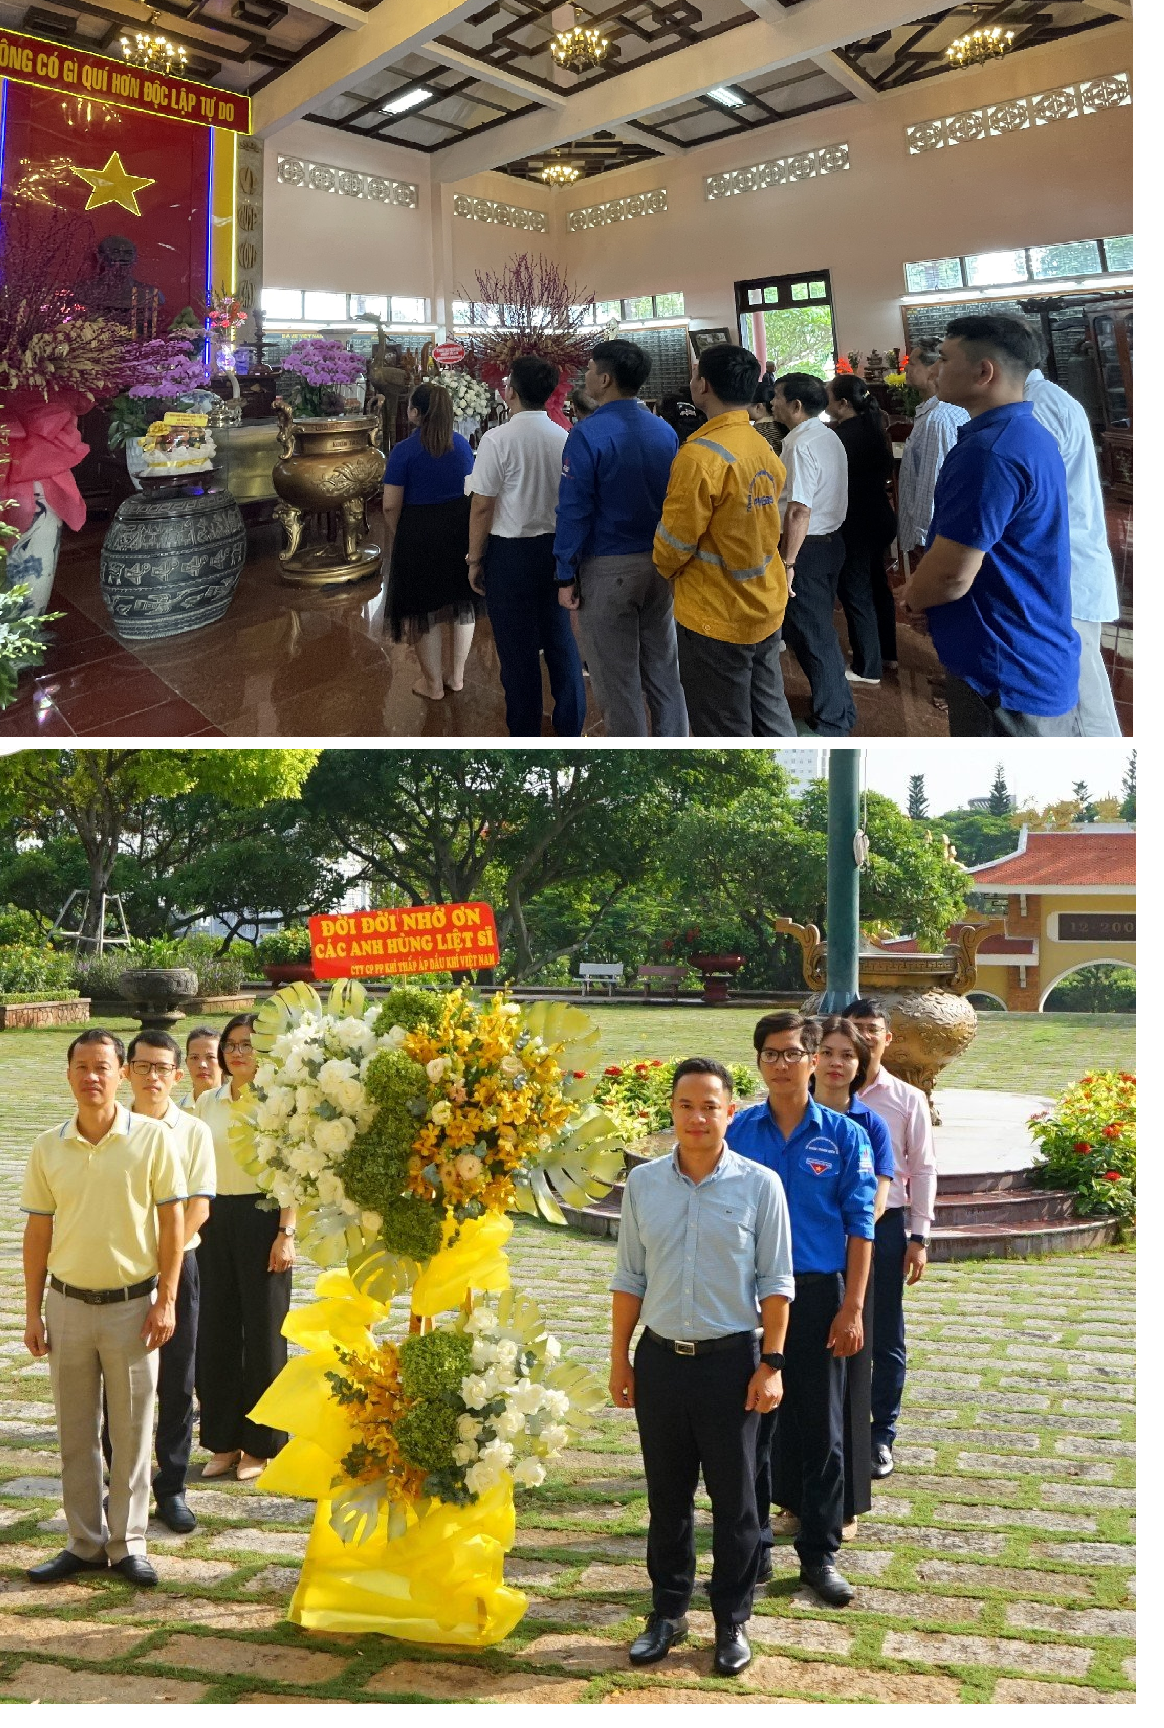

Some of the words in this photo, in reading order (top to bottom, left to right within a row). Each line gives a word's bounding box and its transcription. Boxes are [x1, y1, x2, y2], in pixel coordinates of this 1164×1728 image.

[37, 51, 59, 79] CÓ
[63, 57, 78, 83] GÌ
[81, 64, 109, 92] QUÍ
[111, 72, 140, 98] HƠN
[143, 80, 169, 109] ĐỘC
[171, 88, 197, 115] LẬP
[200, 96, 216, 122] TỰ
[218, 101, 234, 122] DO
[321, 913, 356, 937] ĐỜI
[361, 911, 397, 934] ĐỜI
[451, 906, 481, 927] ƠN
[315, 939, 347, 959] CÁC
[350, 938, 384, 957] ANH
[386, 932, 434, 955] HÙNG
[436, 928, 473, 953] LIỆT
[477, 925, 495, 947] SĨ
[478, 953, 496, 966] NAM
